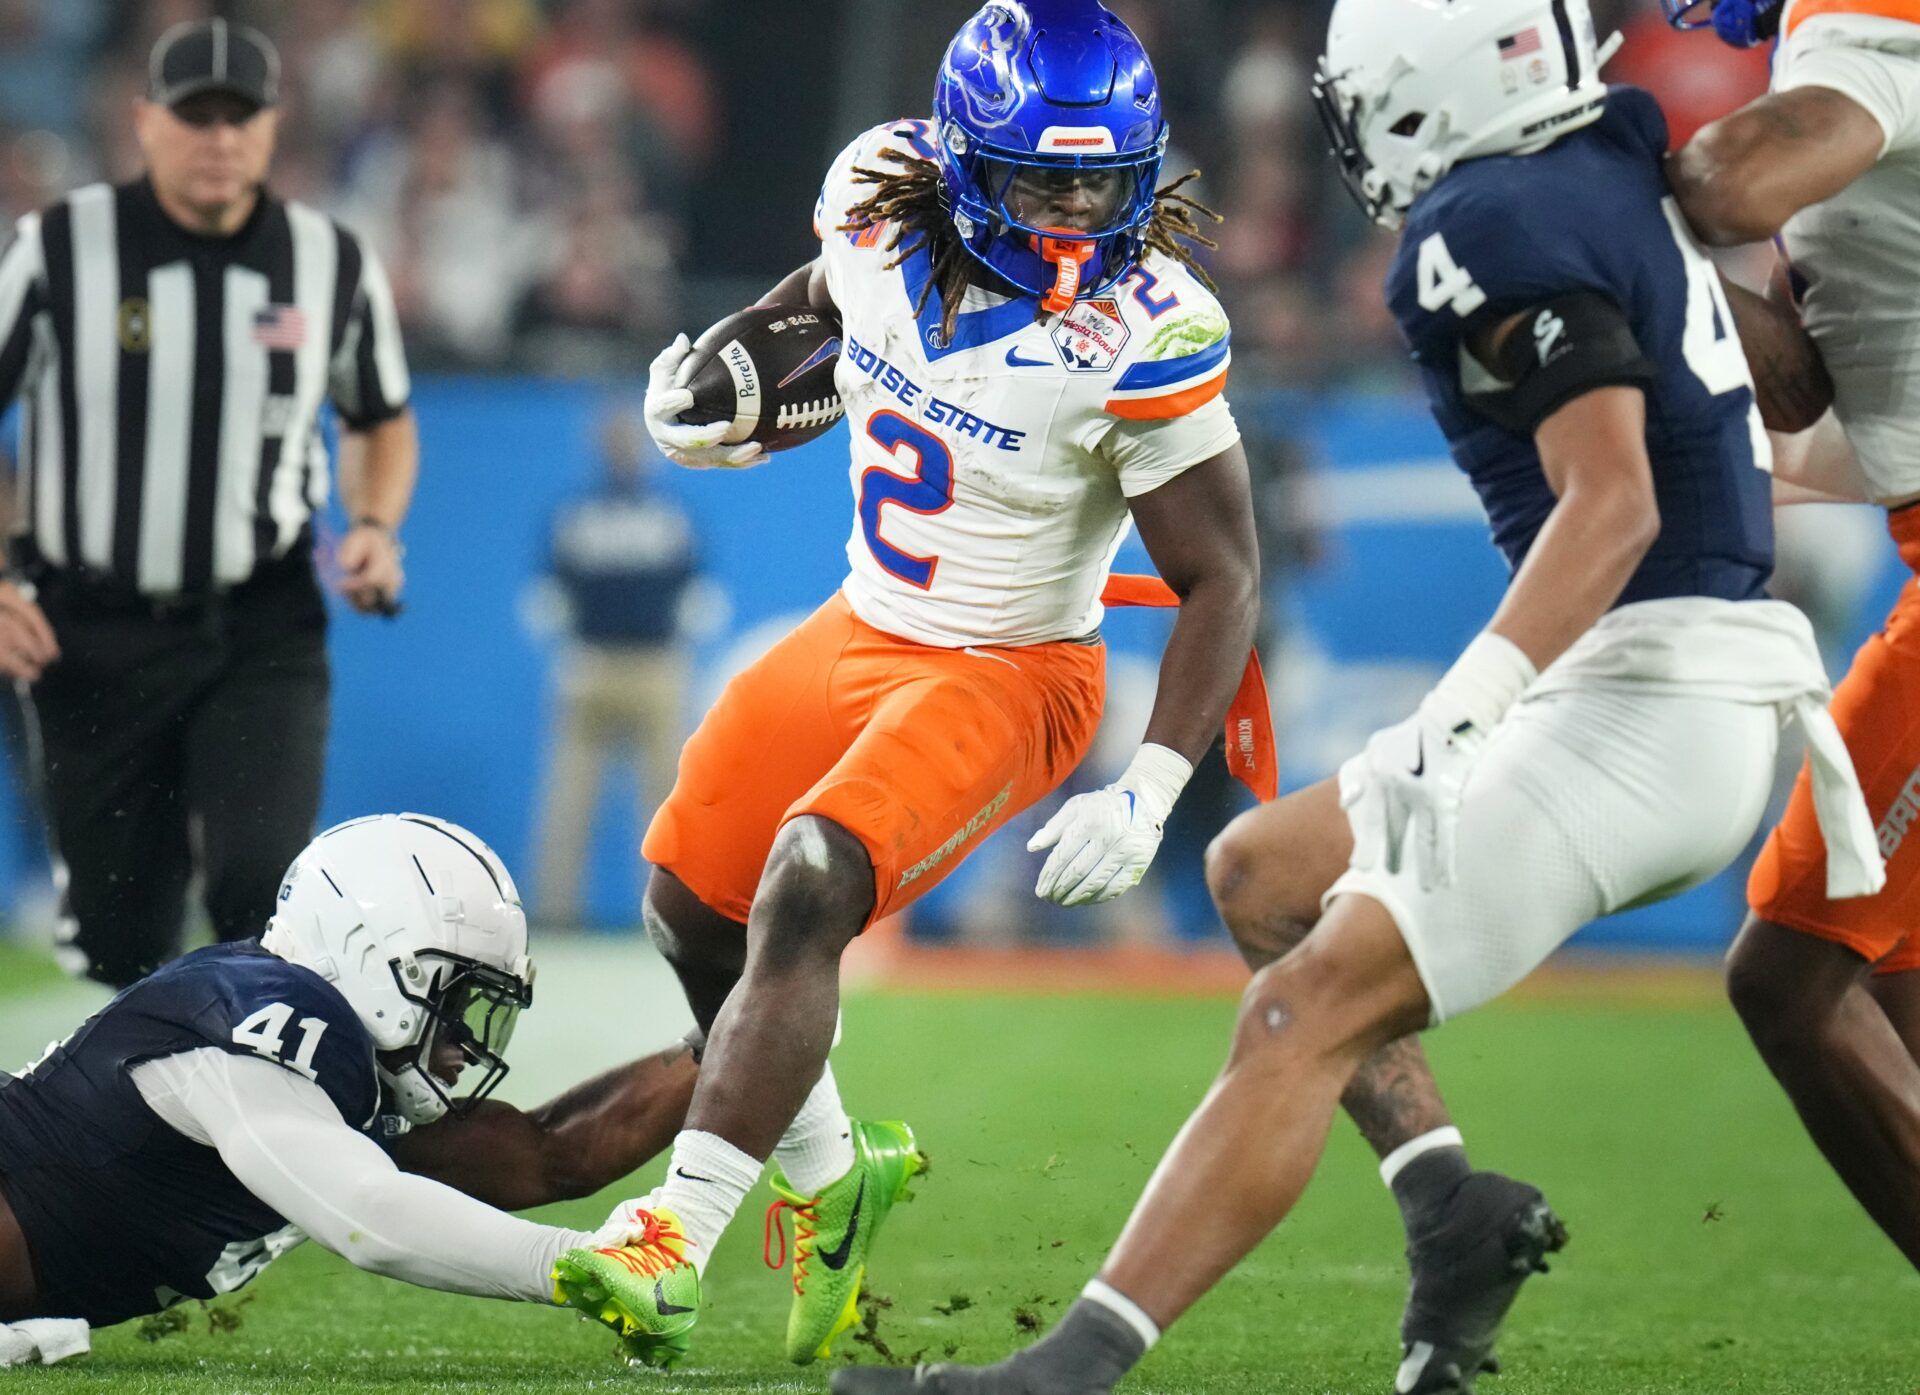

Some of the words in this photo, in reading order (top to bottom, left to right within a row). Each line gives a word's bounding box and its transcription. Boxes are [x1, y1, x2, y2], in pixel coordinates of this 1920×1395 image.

[1116, 264, 1181, 321] 2
[1417, 231, 1487, 317] 4
[731, 346, 756, 398] Perretta
[1063, 319, 1092, 338] Fiesta
[1092, 331, 1117, 356] Bowl
[847, 335, 922, 406] BOISE
[924, 397, 1026, 451] STATE
[858, 408, 955, 592] 2
[232, 1002, 329, 1083] 41
